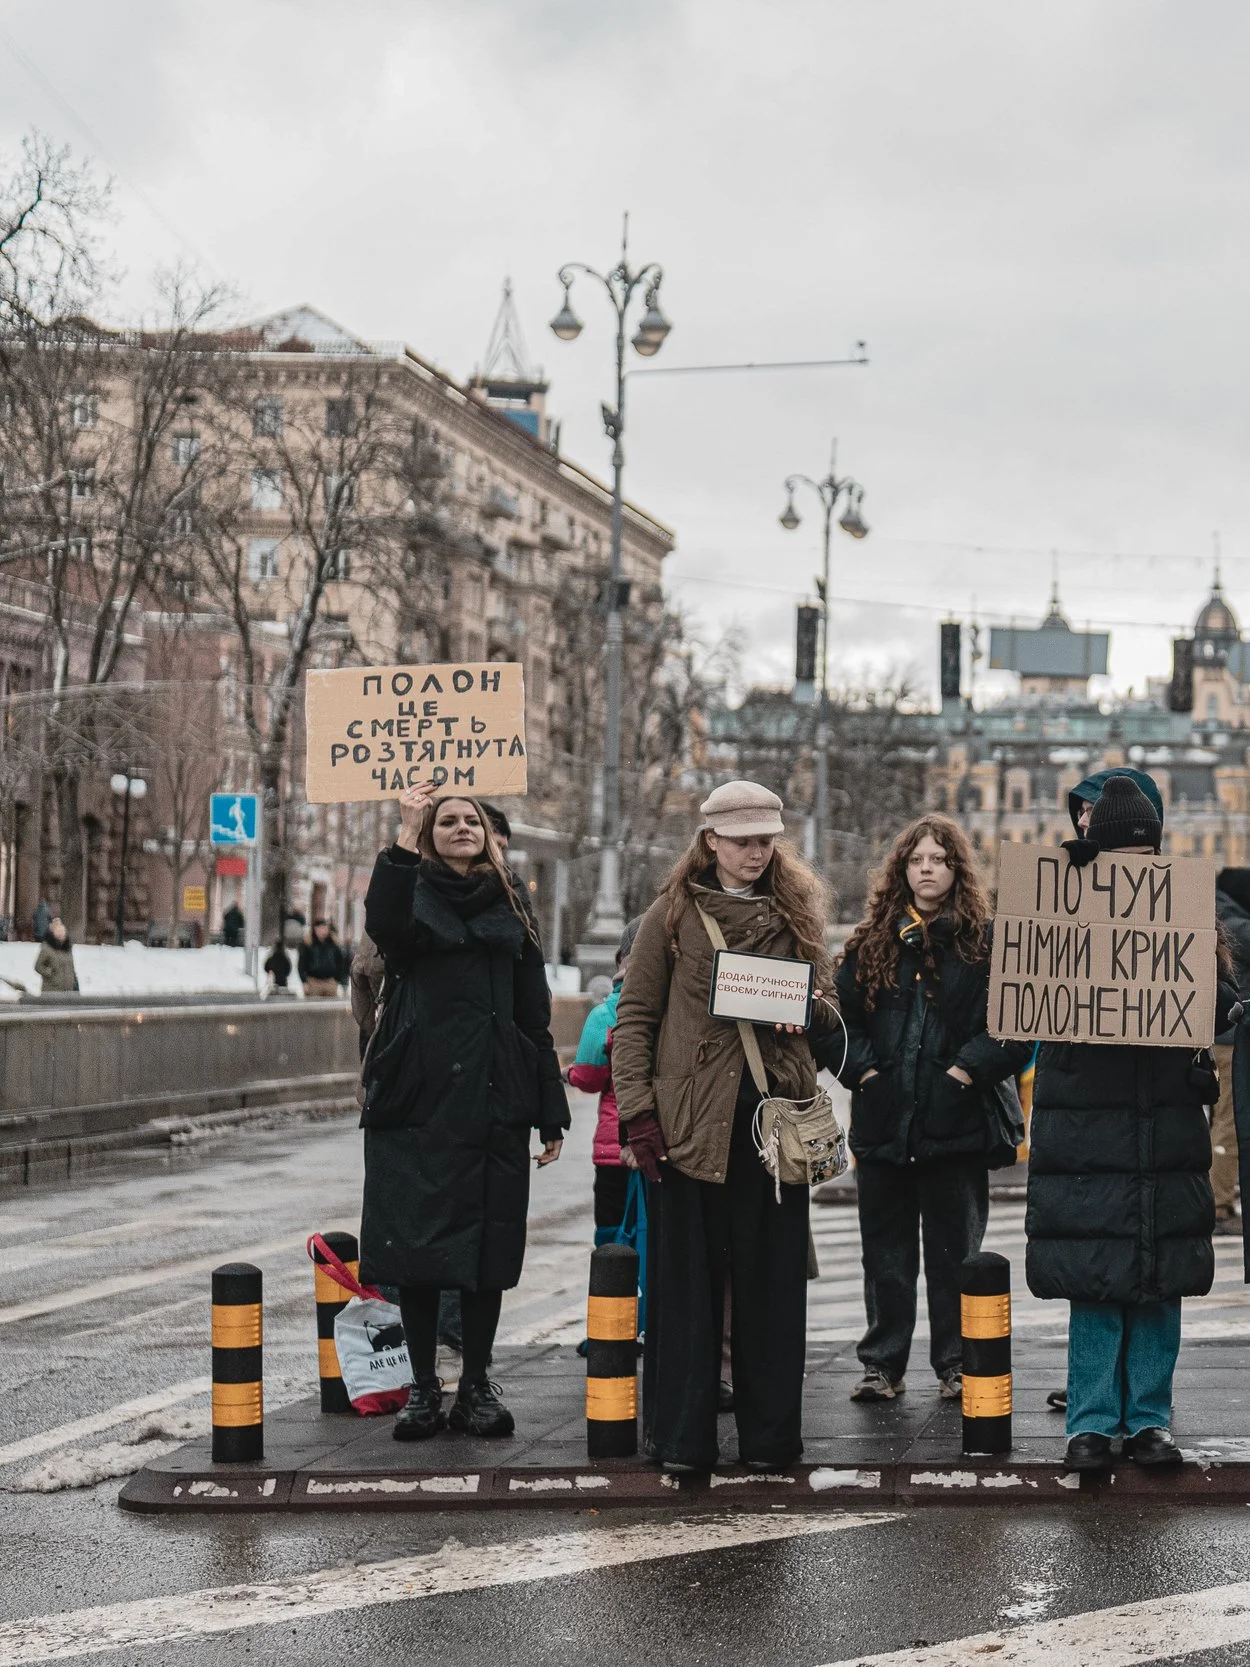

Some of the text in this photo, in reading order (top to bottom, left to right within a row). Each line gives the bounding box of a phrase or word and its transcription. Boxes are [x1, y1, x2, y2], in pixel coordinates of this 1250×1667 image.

[363, 669, 501, 696] ПОЛОН
[398, 700, 438, 718] ЦЕ
[346, 716, 487, 739] СМЕРТЬ
[331, 734, 525, 766] РОЗТЯГНУТА
[372, 765, 475, 790] ЧАСОМ
[1036, 857, 1172, 922] ПОЧУЙ
[1001, 919, 1195, 982] НІМИЙ КРИК
[717, 983, 807, 1002] СВОЄМУ СИГНАЛУ
[718, 971, 808, 990] ДОДАЙ ГУЧНОСТИ
[998, 982, 1196, 1037] ПОЛОНЕНИХ
[370, 1359, 385, 1371] АЛЕ
[386, 1355, 397, 1368] ЦЕ
